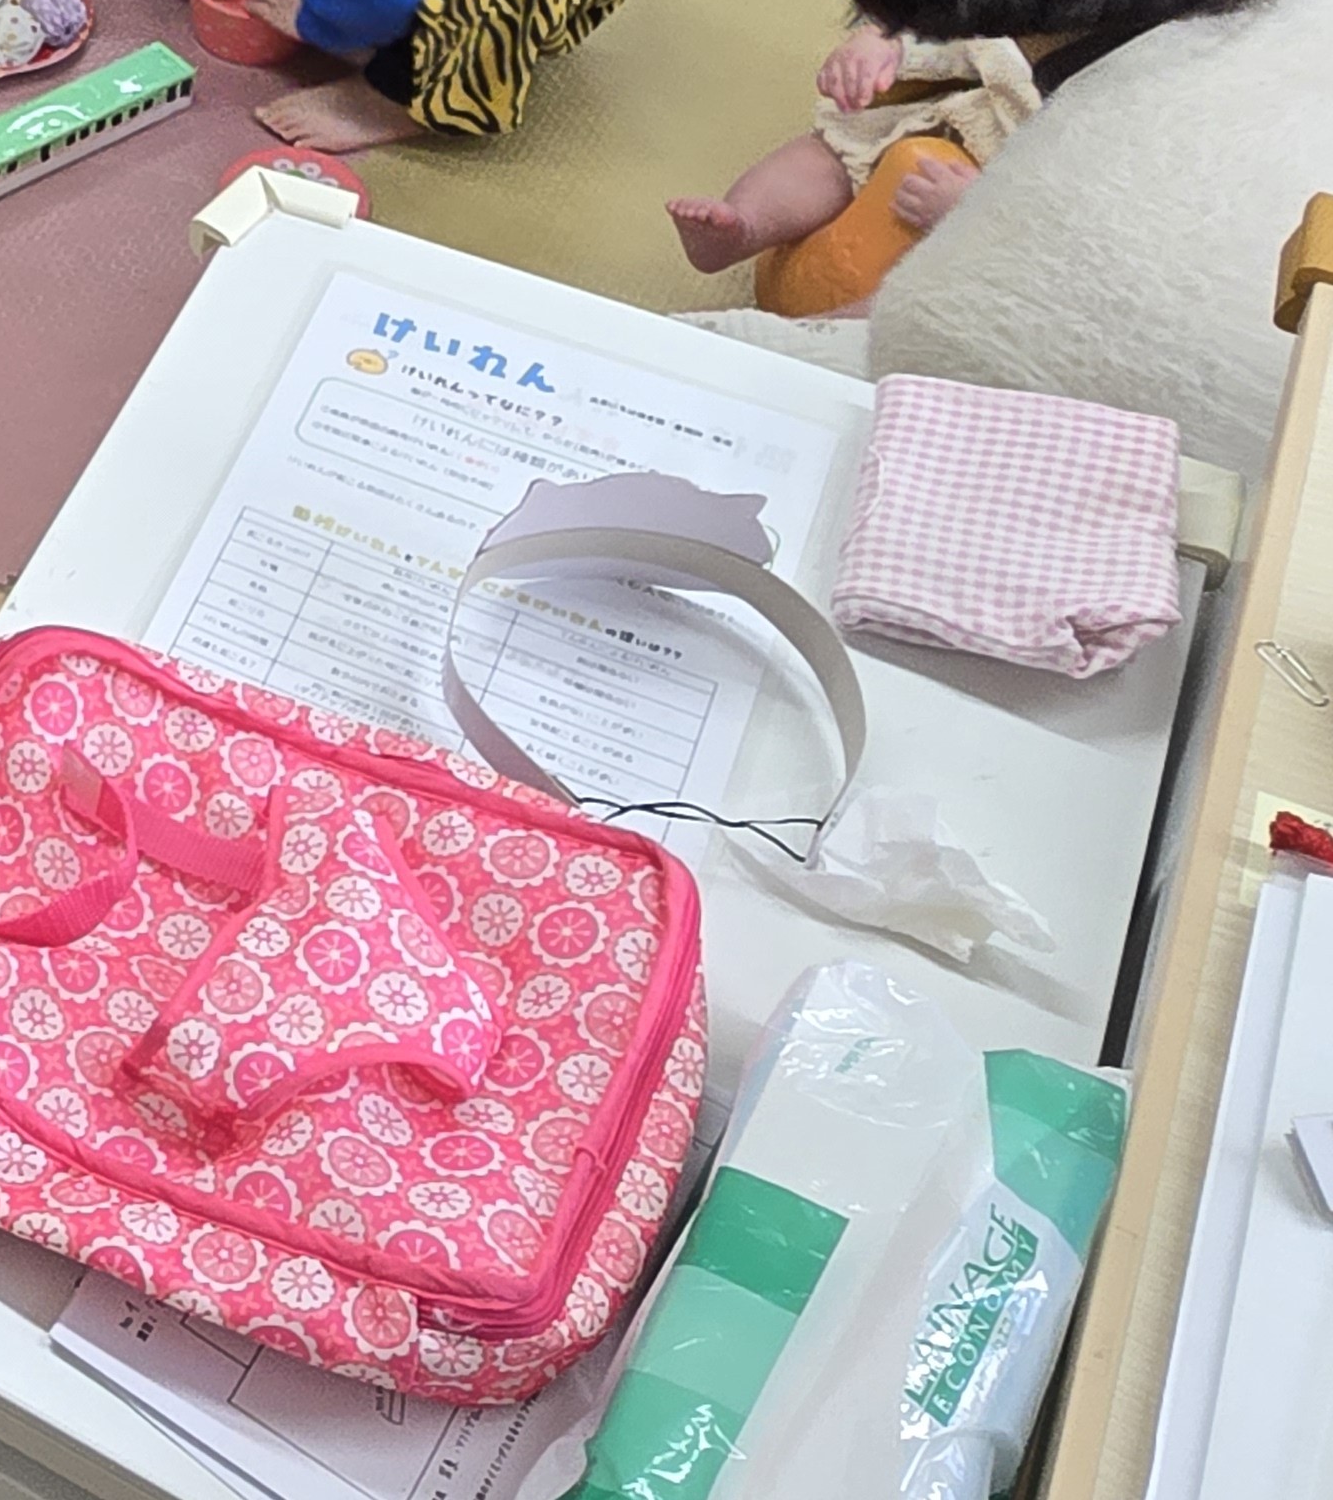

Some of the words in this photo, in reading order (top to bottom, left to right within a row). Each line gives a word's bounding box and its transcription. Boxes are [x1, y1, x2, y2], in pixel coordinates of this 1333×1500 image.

[373, 312, 555, 394] けいれん
[931, 1235, 1032, 1414] ECONOMY
